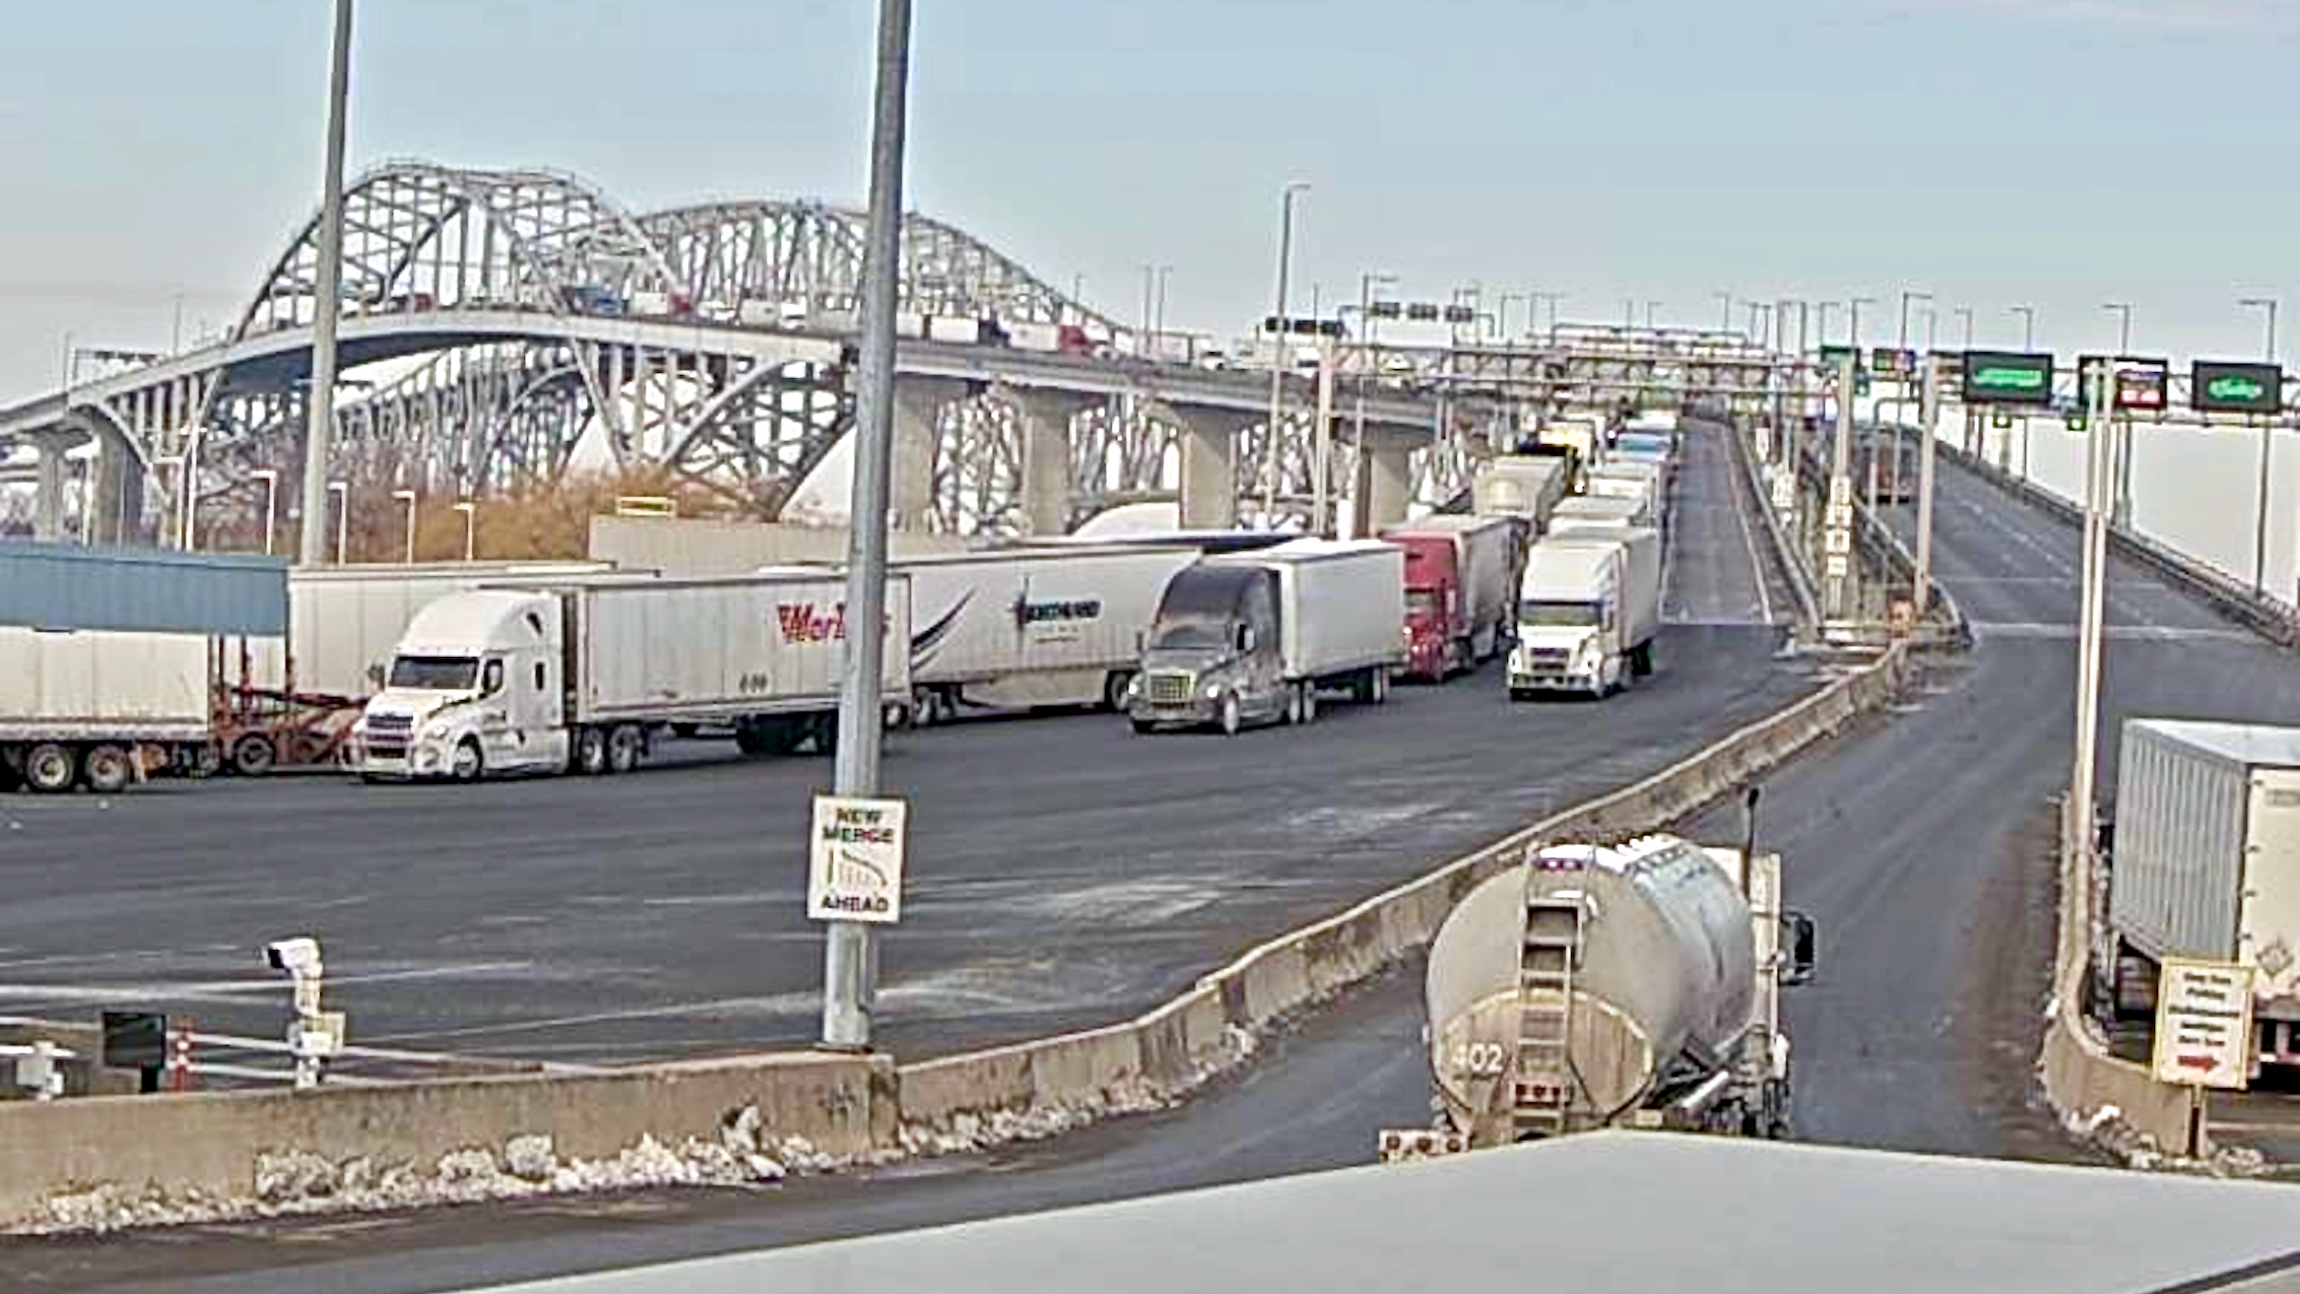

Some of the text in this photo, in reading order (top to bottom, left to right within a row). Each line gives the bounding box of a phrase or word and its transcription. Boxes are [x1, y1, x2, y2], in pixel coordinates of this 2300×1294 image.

[836, 808, 883, 824] NEW
[822, 826, 894, 843] MERGE
[821, 895, 889, 912] AHEAD
[1451, 1043, 1504, 1072] 402
